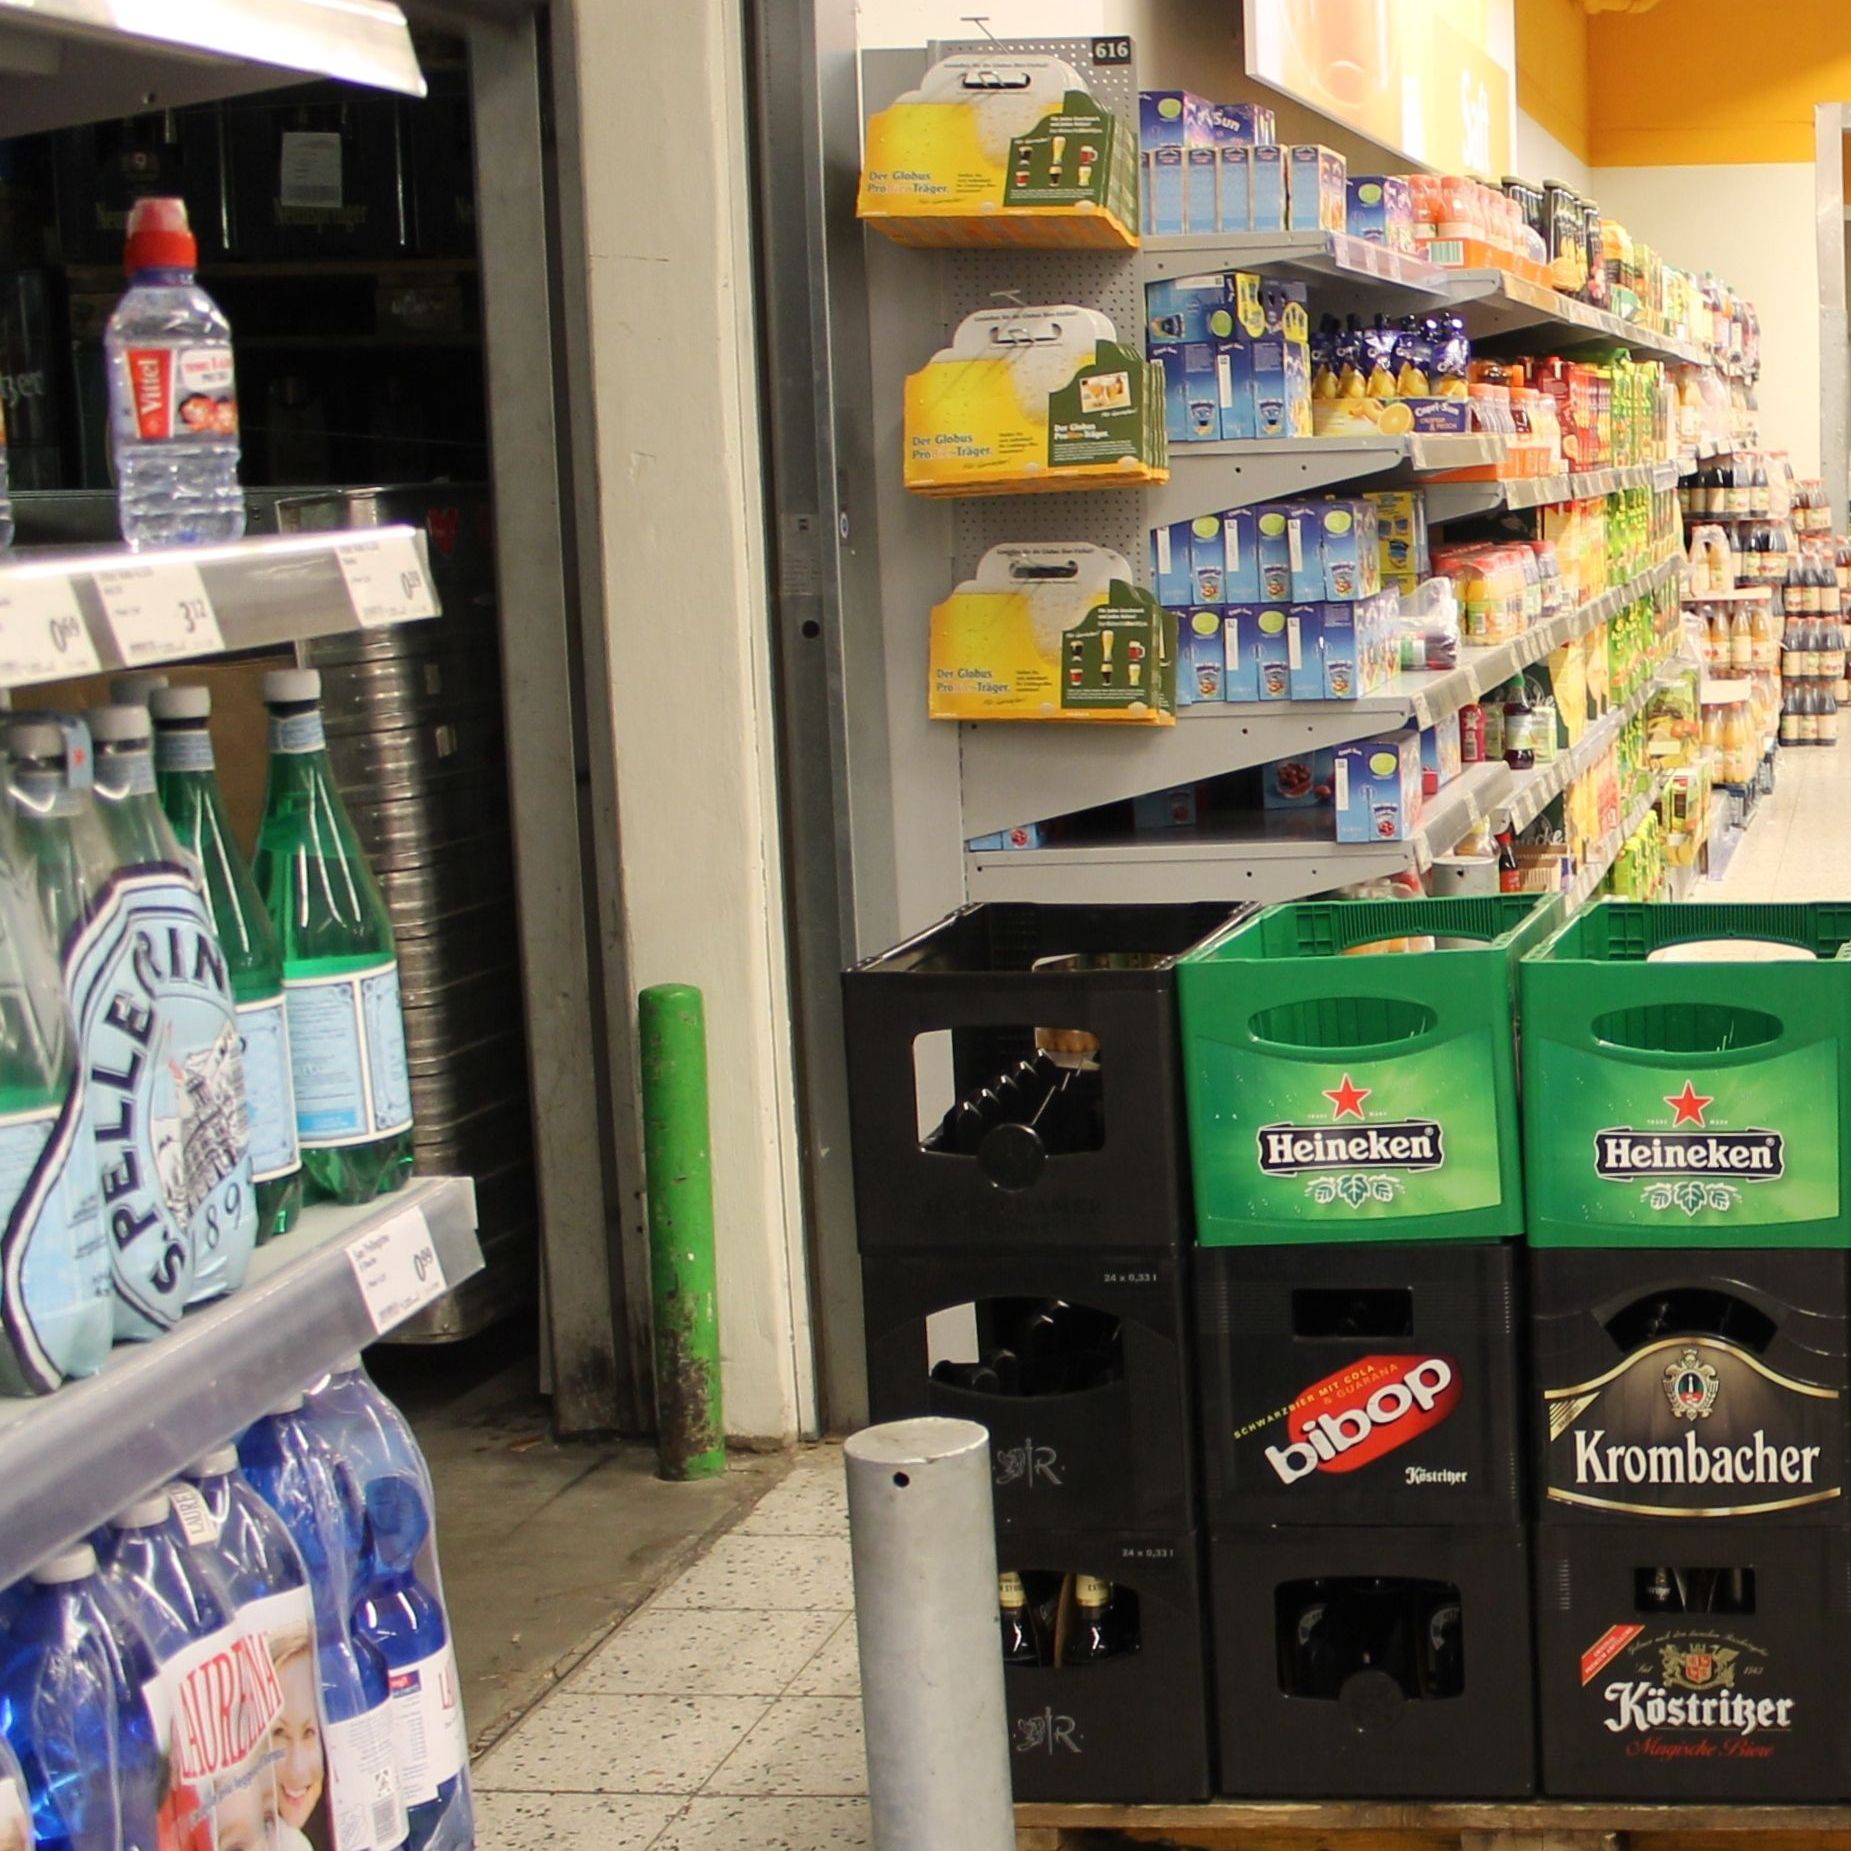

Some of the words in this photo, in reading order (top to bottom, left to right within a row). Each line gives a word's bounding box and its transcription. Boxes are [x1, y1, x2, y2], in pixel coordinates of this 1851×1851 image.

[1095, 42, 1128, 59] 616
[138, 360, 162, 416] Vittel
[1267, 1129, 1434, 1163] Heineken
[1604, 1138, 1773, 1169] Heineken
[1233, 1394, 1315, 1440] SCHWARZBIER
[1318, 1382, 1340, 1397] MIT
[1344, 1364, 1375, 1384] COLA
[1336, 1362, 1399, 1398] GUARANA
[1264, 1359, 1451, 1484] bibop
[1574, 1429, 1821, 1484] Krombacher
[1604, 1681, 1795, 1735] Köstritzer
